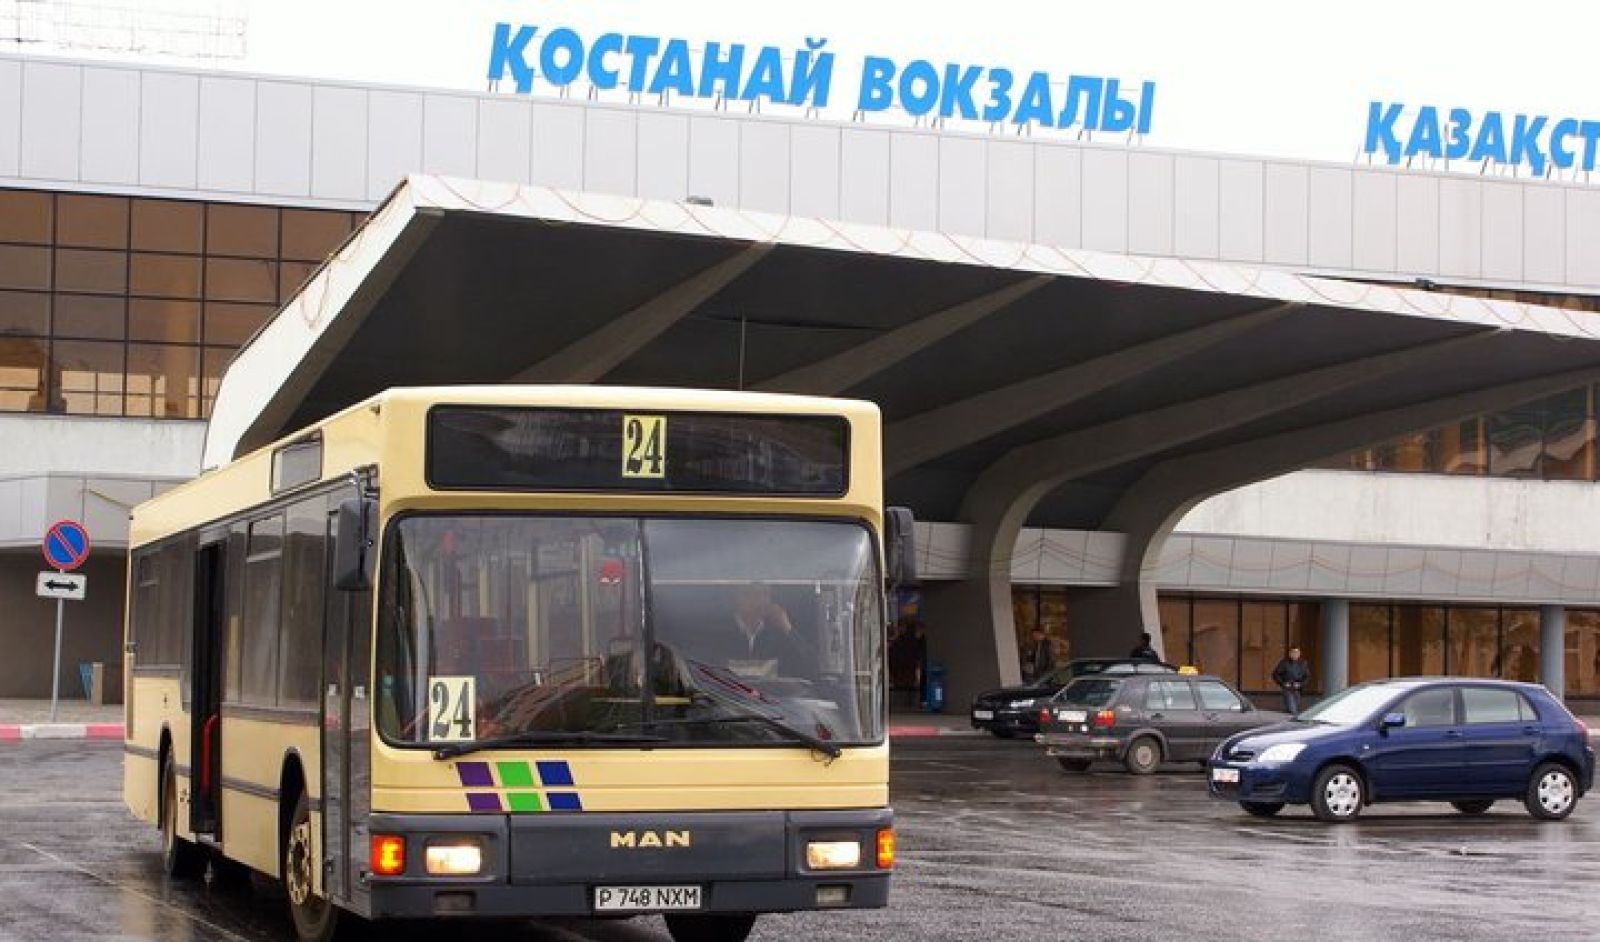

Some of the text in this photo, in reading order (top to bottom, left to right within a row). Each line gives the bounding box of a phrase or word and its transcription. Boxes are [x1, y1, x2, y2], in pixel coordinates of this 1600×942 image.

[488, 22, 1156, 135] ҚОСТАНАЙ ВОКЗАЛЫ
[1364, 101, 1600, 176] ҚАЗАҚСТ
[627, 418, 663, 473] 24
[432, 681, 472, 738] 24
[610, 831, 691, 848] MAN
[599, 889, 697, 907] P 748 NXM
